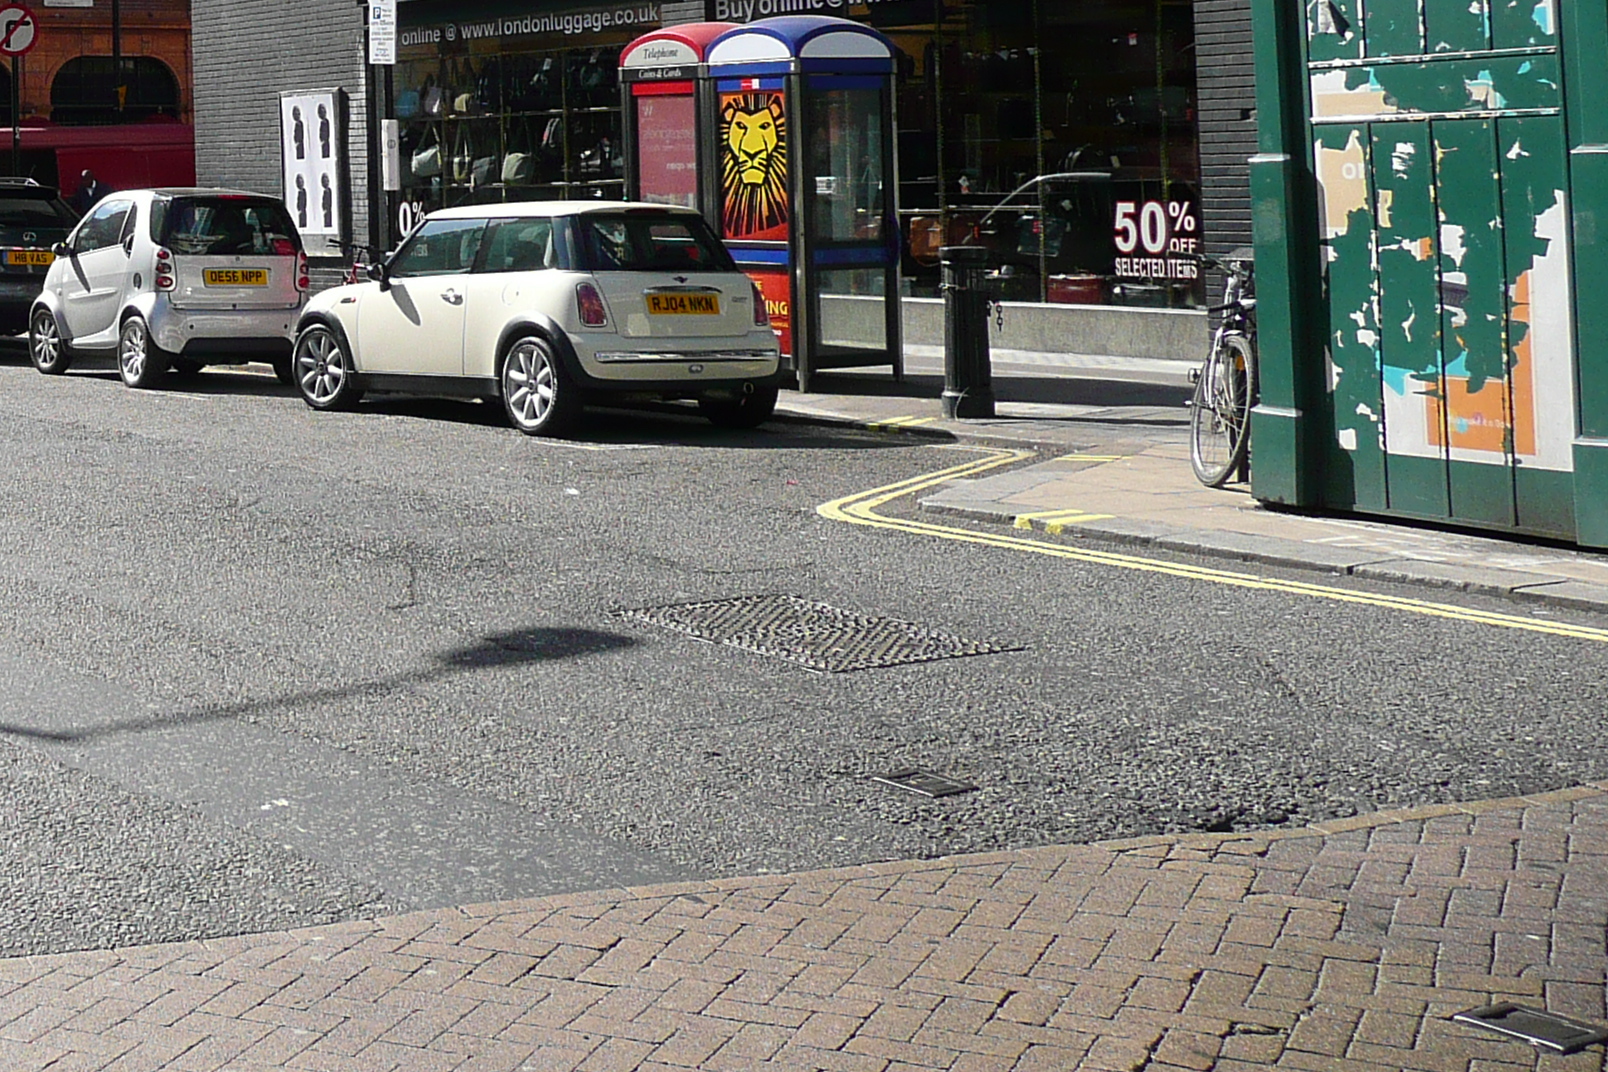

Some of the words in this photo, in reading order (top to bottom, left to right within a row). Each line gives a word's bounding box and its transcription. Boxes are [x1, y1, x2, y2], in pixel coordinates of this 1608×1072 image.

[402, 28, 440, 46] online
[445, 24, 457, 41] @
[461, 3, 658, 39] www.londonluggage.co.uk
[644, 48, 679, 62] Telephone
[639, 69, 656, 78] Coins
[663, 68, 682, 77] Cards
[1170, 238, 1196, 253] OFF
[29, 252, 47, 263] VAS
[1115, 258, 1165, 277] SELECTED
[1167, 259, 1197, 278] ITEMS
[210, 271, 239, 283] OE56
[241, 271, 262, 283] NPP
[652, 297, 686, 310] RJ04
[689, 297, 714, 311] NKN
[765, 299, 788, 315] ING
